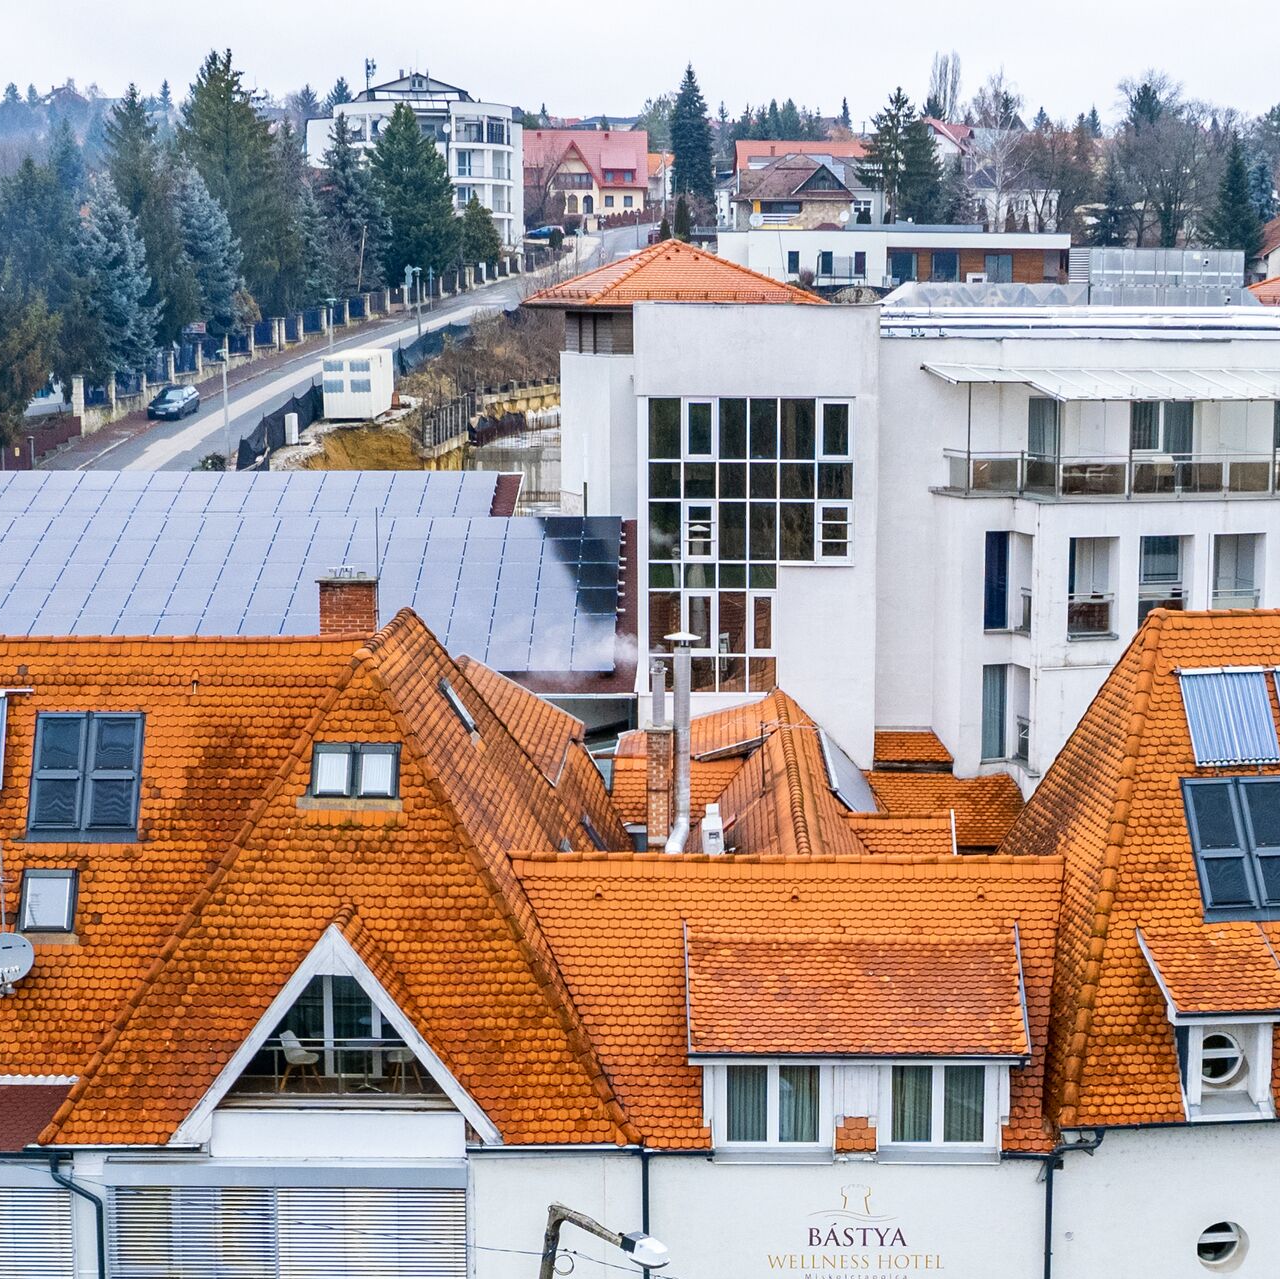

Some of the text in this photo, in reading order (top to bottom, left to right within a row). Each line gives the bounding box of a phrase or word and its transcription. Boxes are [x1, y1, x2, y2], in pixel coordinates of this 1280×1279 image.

[808, 1222, 908, 1247] BÁSTYA
[767, 1254, 945, 1270] WELLNESS HOTEL
